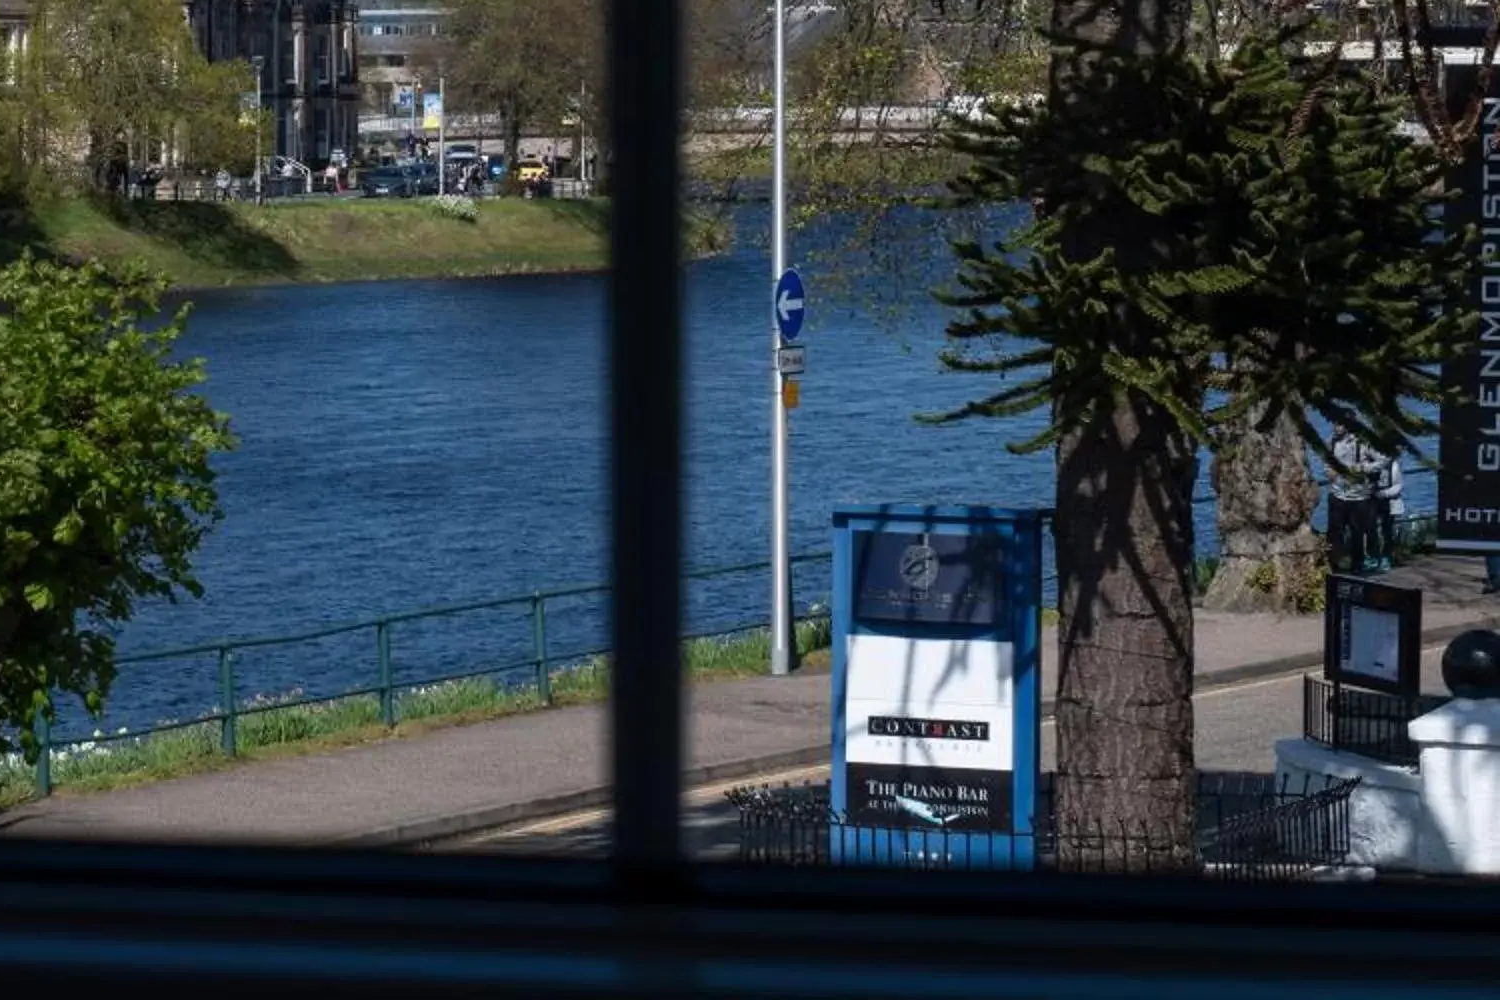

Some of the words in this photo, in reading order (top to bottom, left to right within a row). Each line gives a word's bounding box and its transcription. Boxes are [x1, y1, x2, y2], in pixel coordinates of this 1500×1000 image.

[1446, 507, 1500, 523] HOT
[871, 718, 985, 738] CONTRAST
[866, 779, 897, 796] THE
[903, 782, 953, 799] PIANO
[957, 785, 988, 802] BAR
